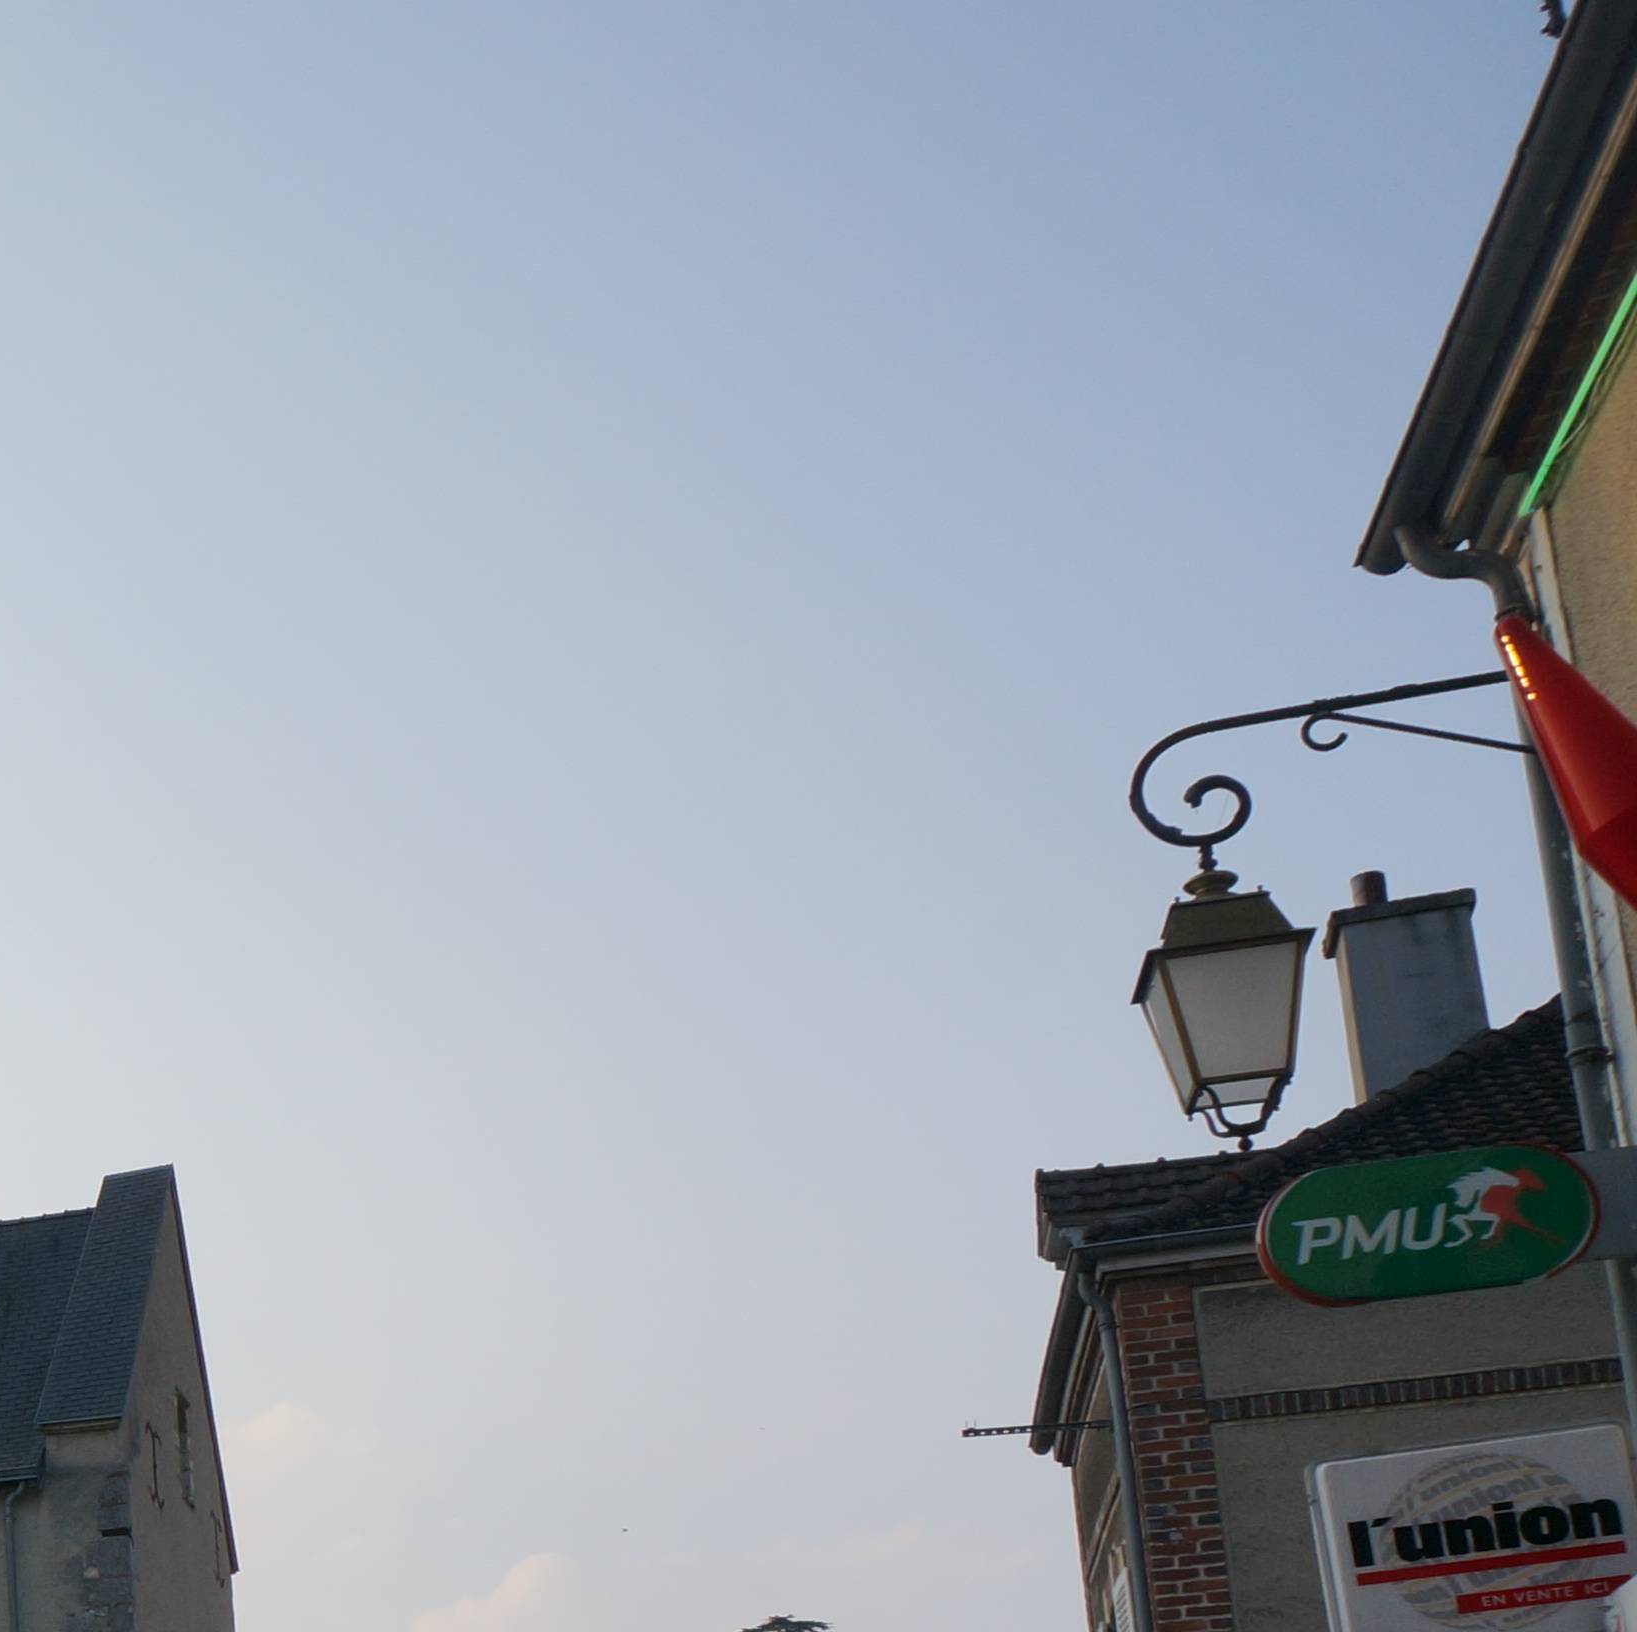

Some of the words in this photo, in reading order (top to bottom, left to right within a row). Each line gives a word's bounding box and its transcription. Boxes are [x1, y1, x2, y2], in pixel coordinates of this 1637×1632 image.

[1292, 1203, 1446, 1266] PMU
[1347, 1498, 1623, 1567] l'union
[1481, 1594, 1507, 1608] EN
[1513, 1586, 1574, 1603] VENTE
[1585, 1582, 1609, 1595] ICI
